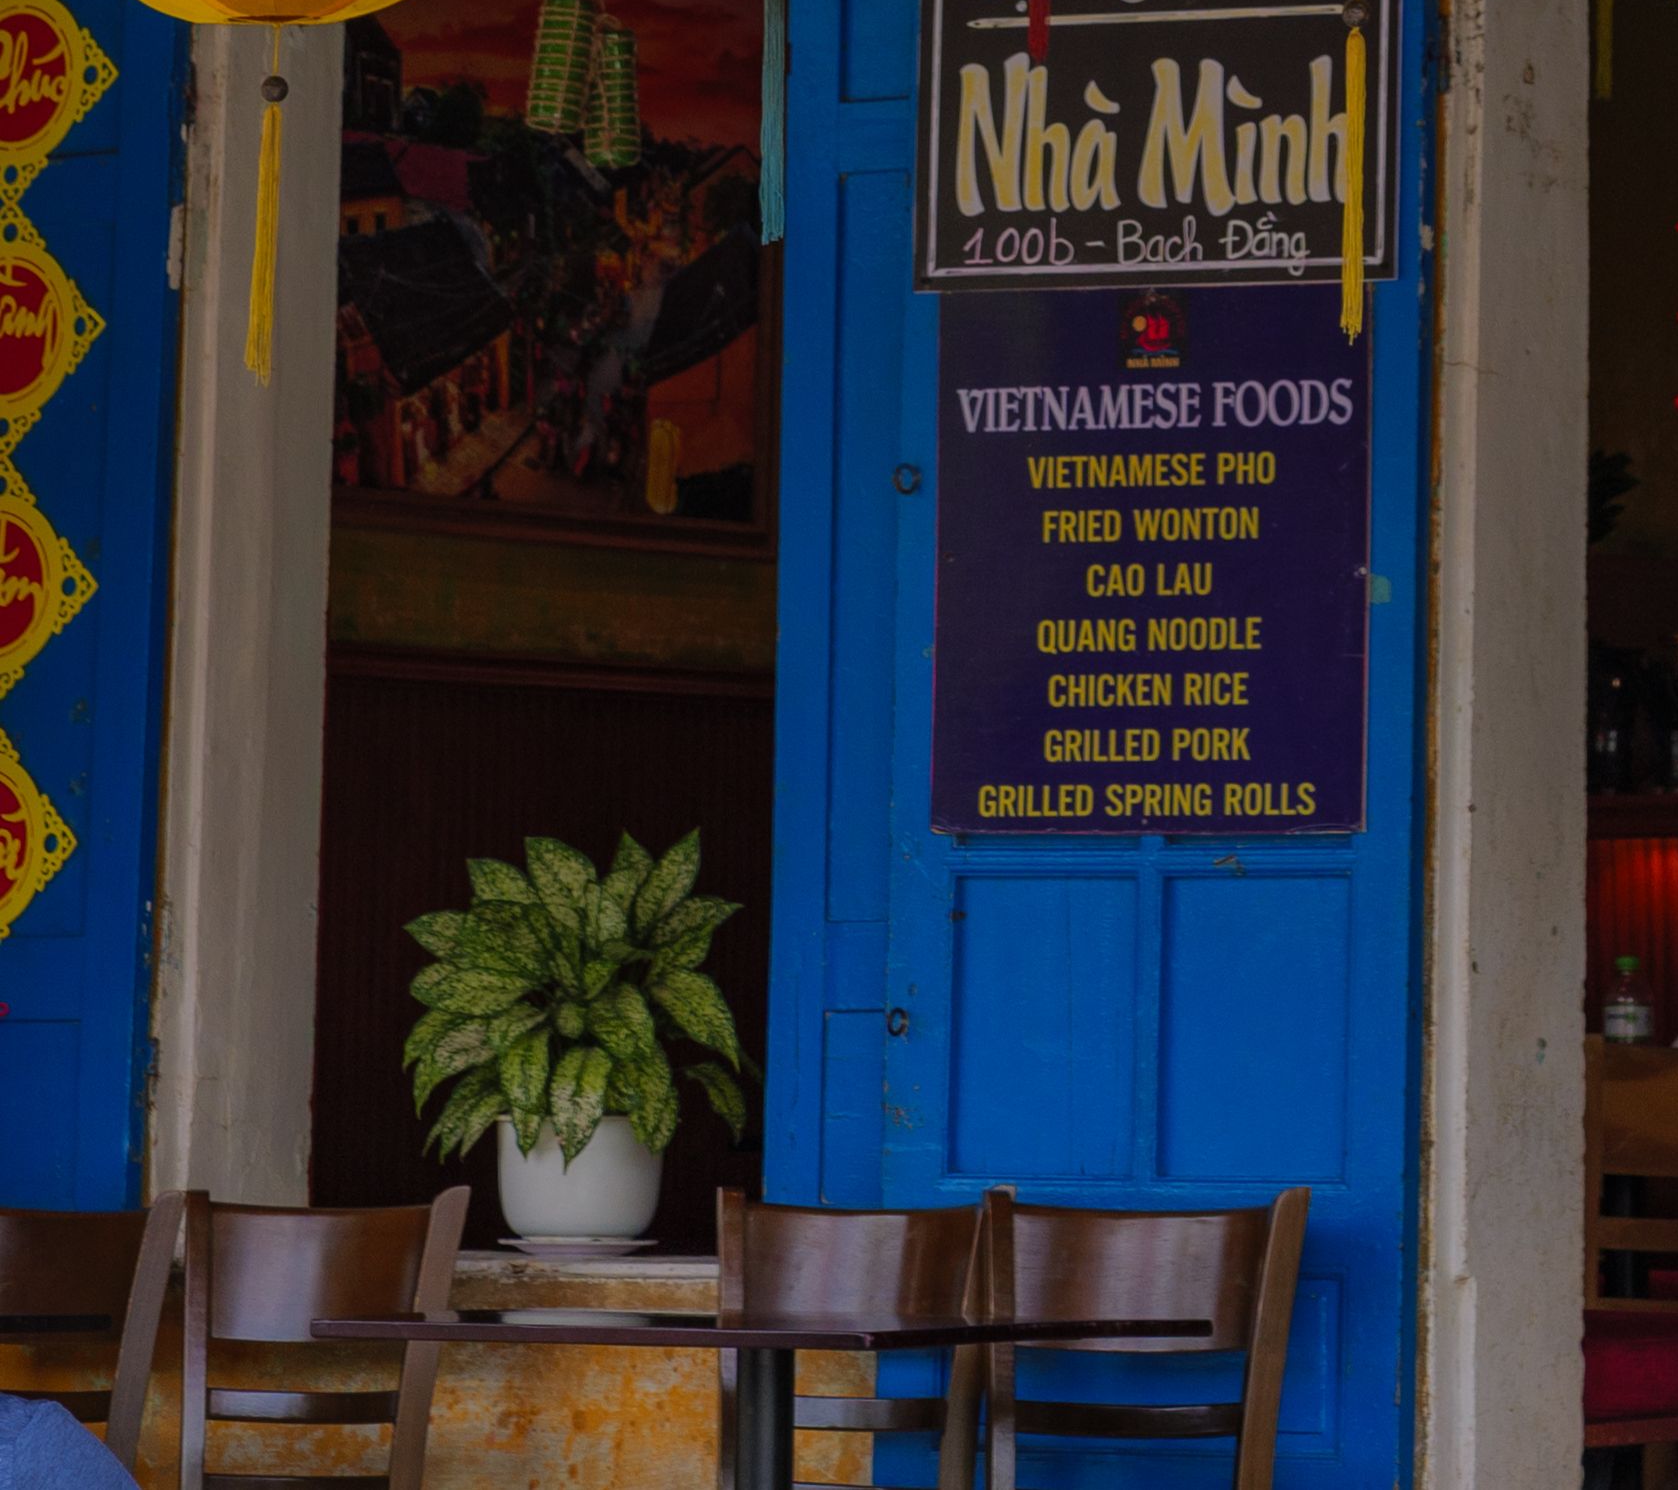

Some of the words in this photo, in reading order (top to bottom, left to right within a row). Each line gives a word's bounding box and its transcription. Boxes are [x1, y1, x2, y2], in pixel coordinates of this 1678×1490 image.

[955, 51, 1122, 218] Nhà
[1137, 54, 1349, 218] Mình
[962, 217, 1075, 265] 100b
[956, 382, 1202, 433] VIETNAMESE
[1211, 378, 1354, 427] FOODS
[1027, 452, 1207, 490] VIETNAMESE
[1216, 450, 1277, 486] PHO
[1042, 509, 1122, 544] FRIED
[1133, 506, 1260, 542] WONTON
[1085, 563, 1146, 598] CAO
[1155, 562, 1213, 597] LAU
[1036, 618, 1137, 655] QUANG
[1147, 616, 1263, 652] NOODLE
[1047, 672, 1173, 708] CHICKEN
[1183, 671, 1250, 706] RICE
[1043, 728, 1161, 763] GRILLED
[1171, 727, 1252, 761] PORK
[977, 783, 1095, 818] GRILLED
[1104, 782, 1213, 817] SPRING
[1223, 781, 1317, 816] ROLLS
